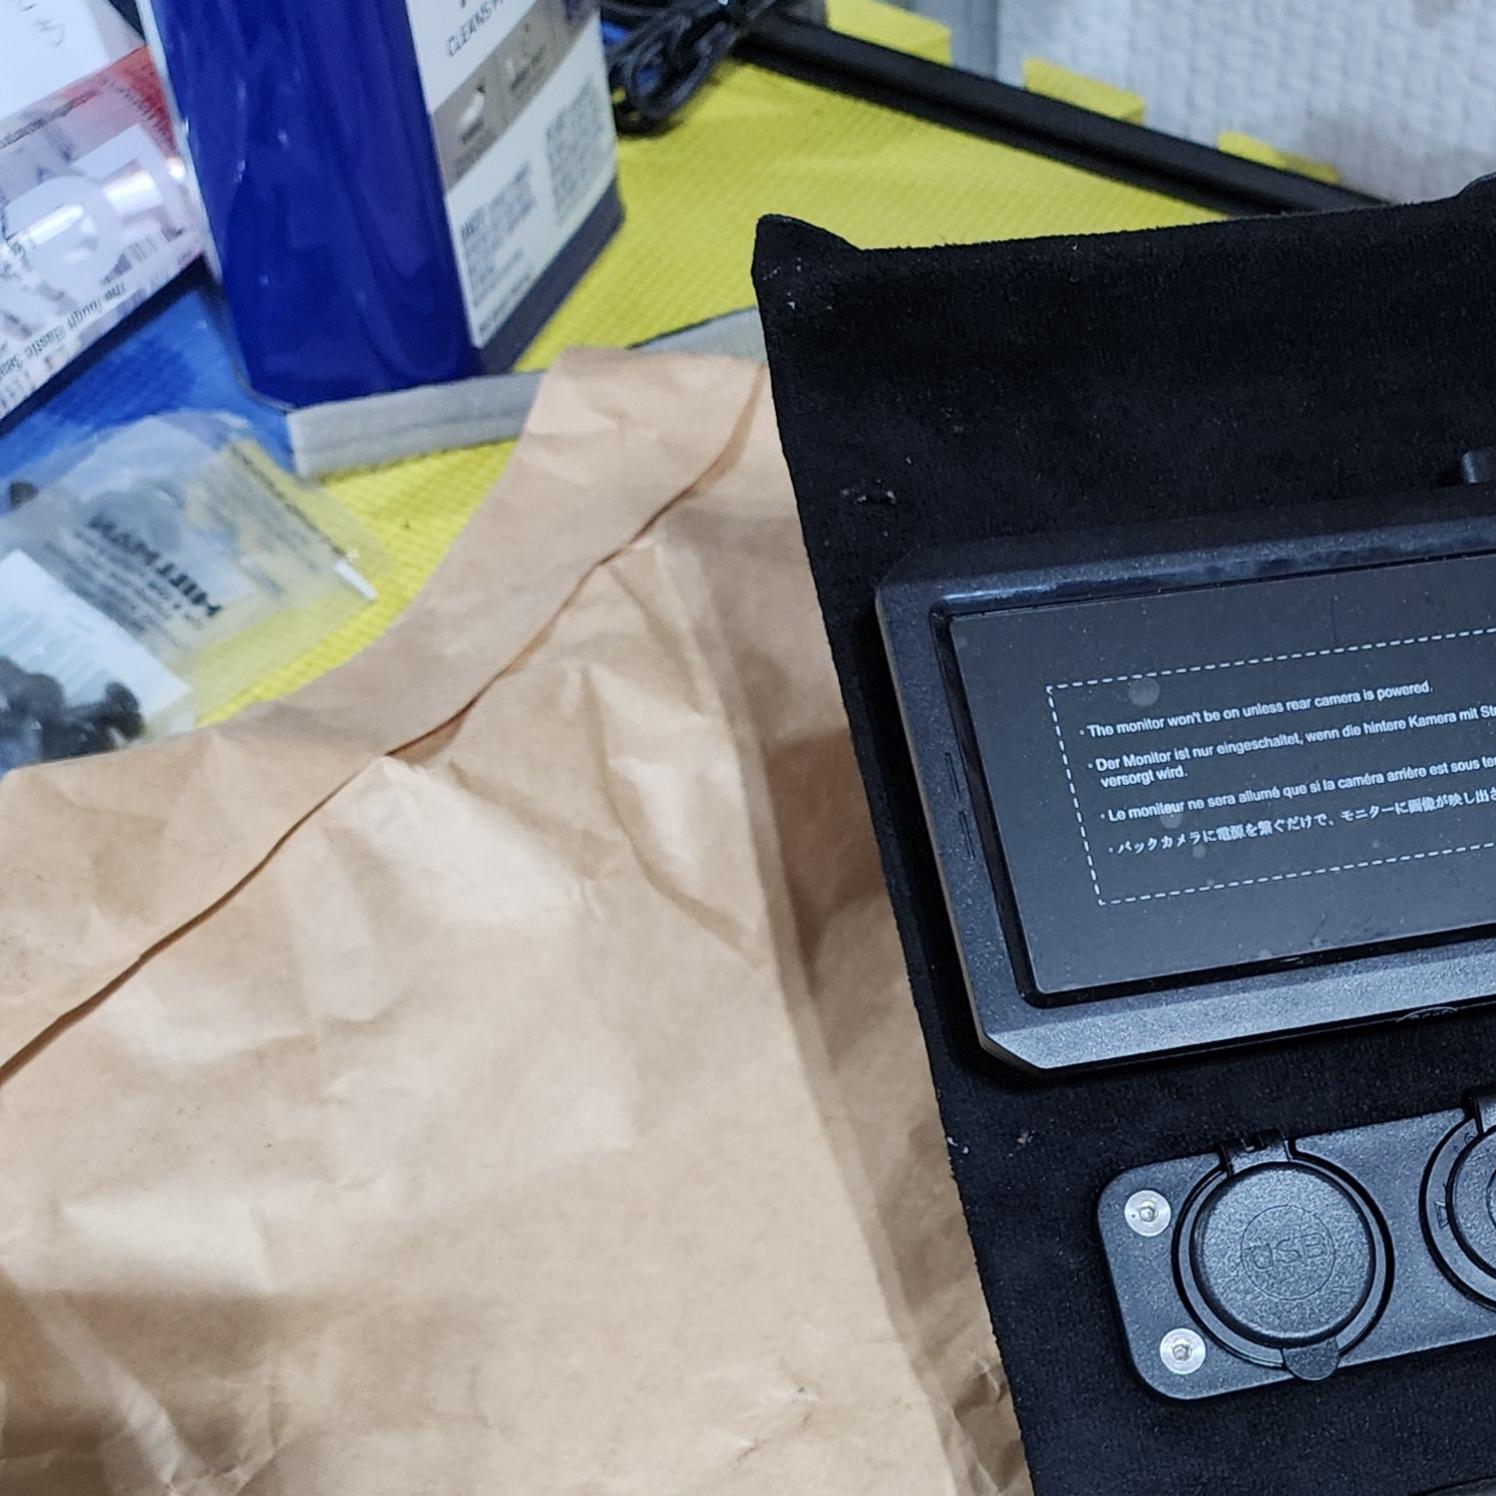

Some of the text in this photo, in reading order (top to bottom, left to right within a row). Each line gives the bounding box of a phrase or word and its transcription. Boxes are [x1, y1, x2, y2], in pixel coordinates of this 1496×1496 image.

[1086, 679, 1433, 739] The monitor won't be on unless rear camera is powered.
[1095, 756, 1121, 773] Der
[1122, 750, 1172, 769] Monitor
[1173, 747, 1192, 761] ist
[1193, 745, 1214, 758] nur
[1215, 732, 1304, 756] eingeschaltet,
[1305, 728, 1341, 744] wenn
[1341, 723, 1362, 739] die
[1363, 717, 1407, 736] hintere
[1408, 711, 1457, 730] Kamera
[1458, 708, 1479, 722] mit
[1100, 765, 1189, 789] versorgt wird.
[1107, 808, 1127, 824] Le
[1127, 800, 1185, 820] moniteur
[1187, 798, 1205, 811] ne
[1206, 795, 1237, 809] sera
[1237, 785, 1281, 804] allumé
[1282, 783, 1308, 800] que
[1309, 780, 1322, 794] si
[1322, 779, 1337, 792] la
[1337, 771, 1385, 789] caméra
[1386, 766, 1428, 784] arrière
[1428, 762, 1449, 776] est
[1450, 757, 1481, 773] sous
[1248, 1231, 1327, 1271] USB
